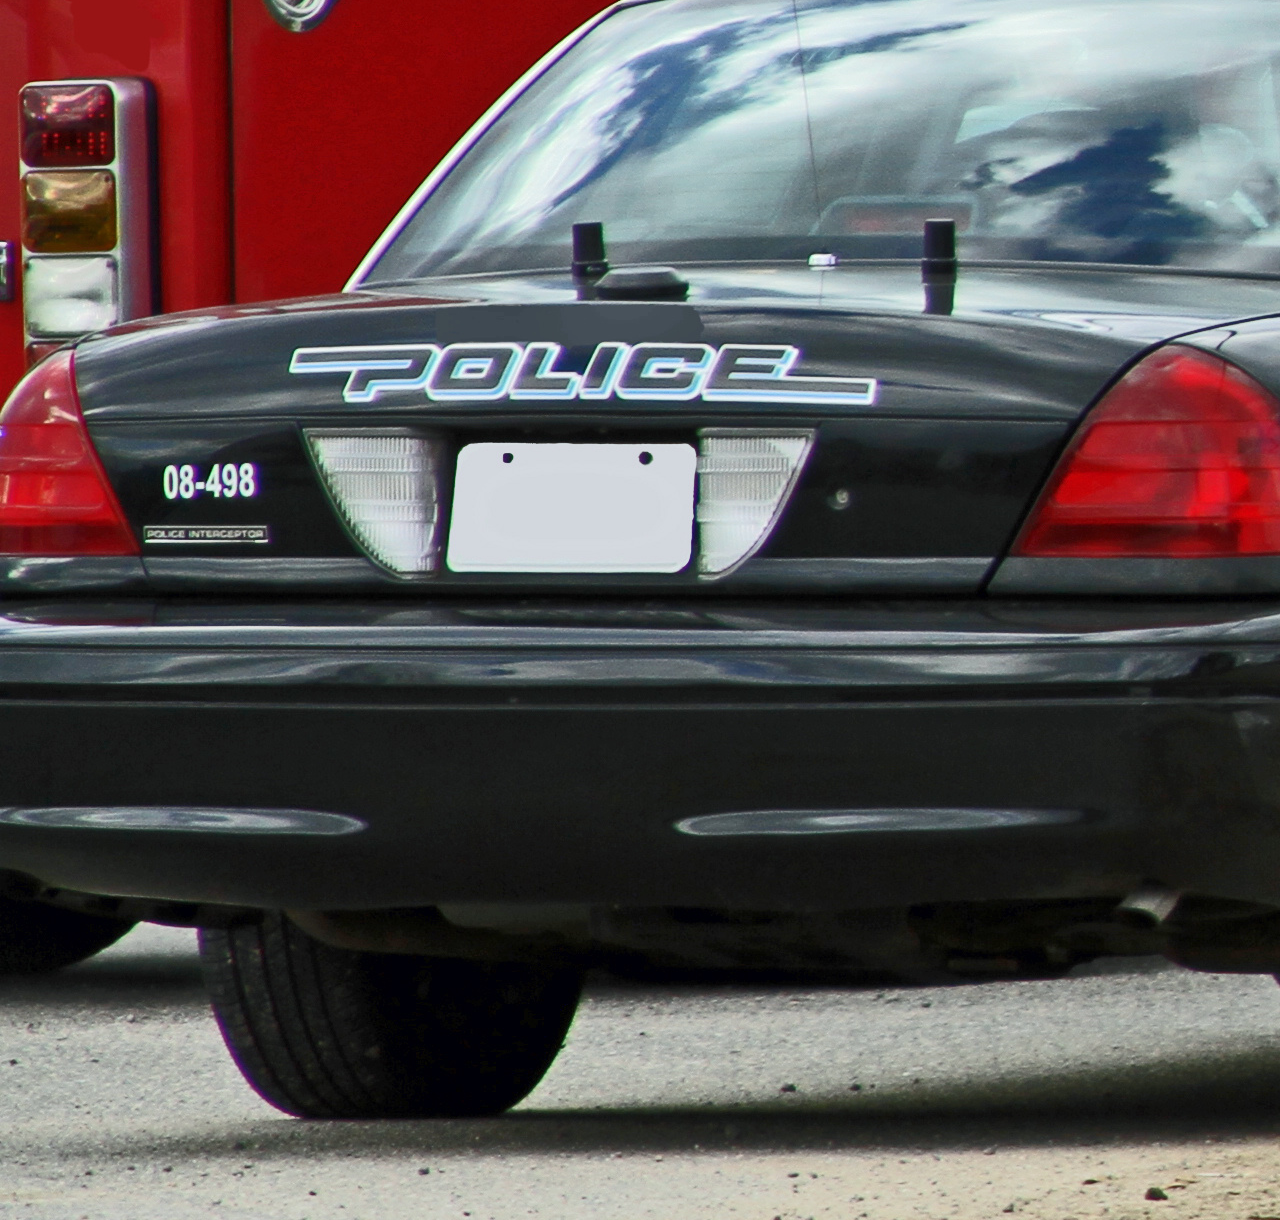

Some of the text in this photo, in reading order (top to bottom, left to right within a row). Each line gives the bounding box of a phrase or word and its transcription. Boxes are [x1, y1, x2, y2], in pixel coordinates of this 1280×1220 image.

[289, 342, 876, 405] POLICE
[163, 463, 255, 499] 08-498
[147, 530, 264, 538] POLICE INTERCEPTOR
